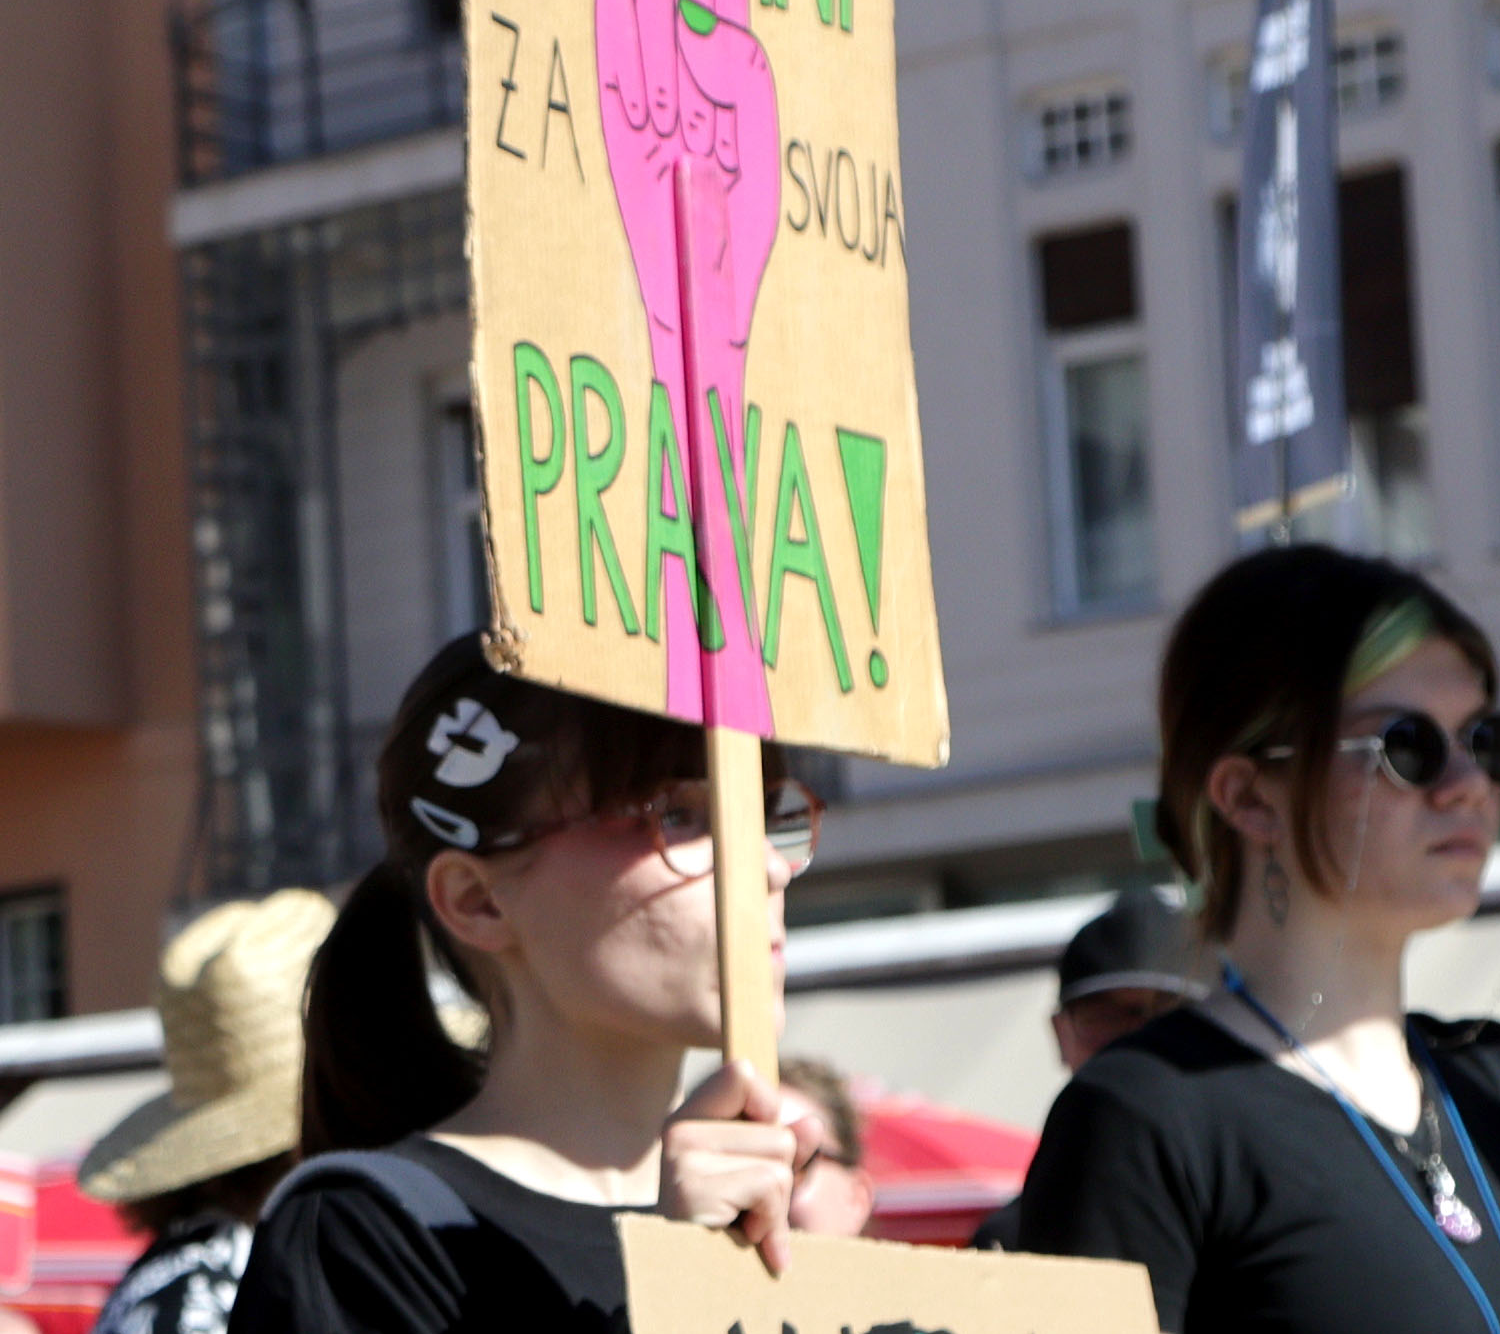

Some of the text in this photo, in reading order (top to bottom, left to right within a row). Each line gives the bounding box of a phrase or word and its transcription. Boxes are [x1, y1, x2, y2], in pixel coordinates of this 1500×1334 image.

[491, 12, 906, 270] ZA SVOJA
[513, 340, 891, 694] PRAVA!
